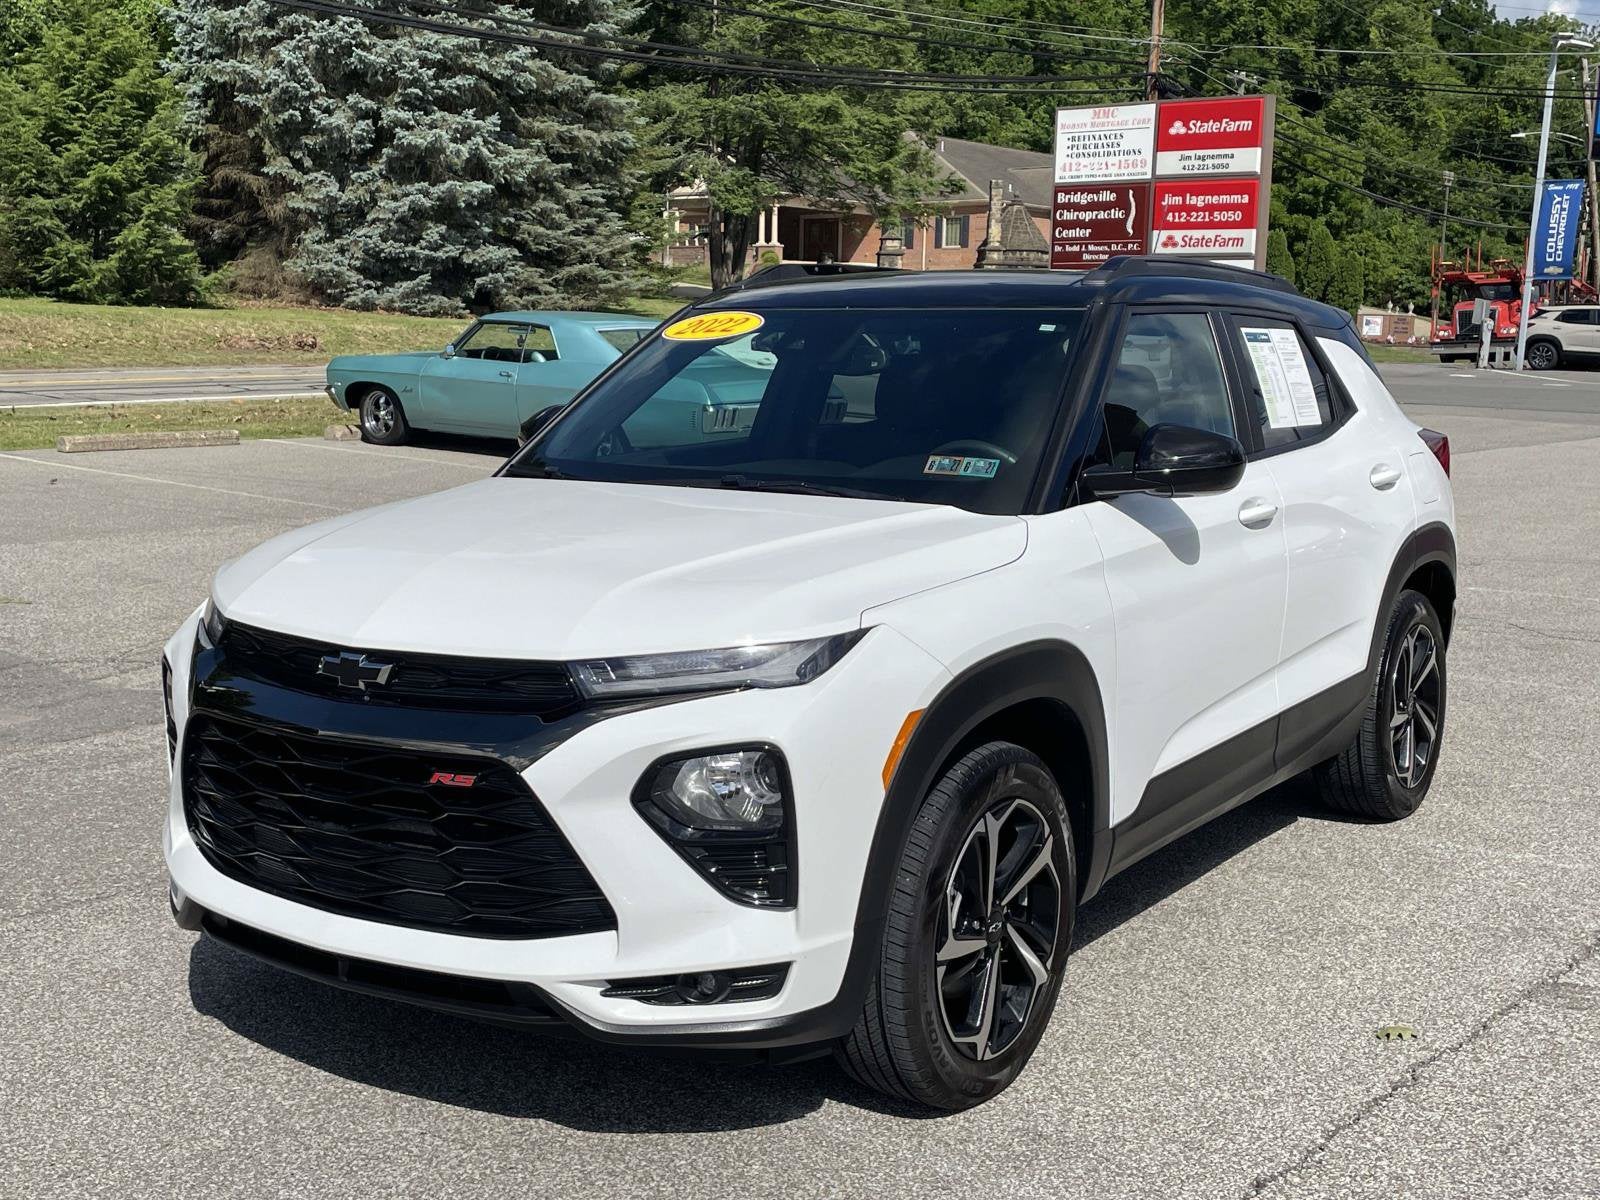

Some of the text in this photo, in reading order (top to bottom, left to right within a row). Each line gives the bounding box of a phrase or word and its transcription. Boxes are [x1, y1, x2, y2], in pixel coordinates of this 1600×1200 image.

[1091, 107, 1119, 120] MMC
[1071, 132, 1124, 142] REFINANCES
[1070, 141, 1121, 151] PURCHASES
[1070, 148, 1142, 159] CONSOLIDATIONS
[1179, 152, 1235, 162] Jim Iagnemma
[1060, 158, 1148, 173] 412-221-1569
[1182, 162, 1230, 171] 412-221-5050
[1057, 190, 1117, 205] Bridgeville
[1161, 193, 1249, 207] Jim Iagnemma
[1056, 207, 1126, 222] Chiropractic
[1166, 211, 1242, 222] 412-221-5050
[1055, 227, 1092, 239] Center
[1546, 193, 1562, 262] COLUSSY
[1555, 193, 1570, 262] CHEVROLET
[1065, 244, 1080, 252] Todd
[672, 317, 750, 335] 2022
[430, 772, 477, 787] RS
